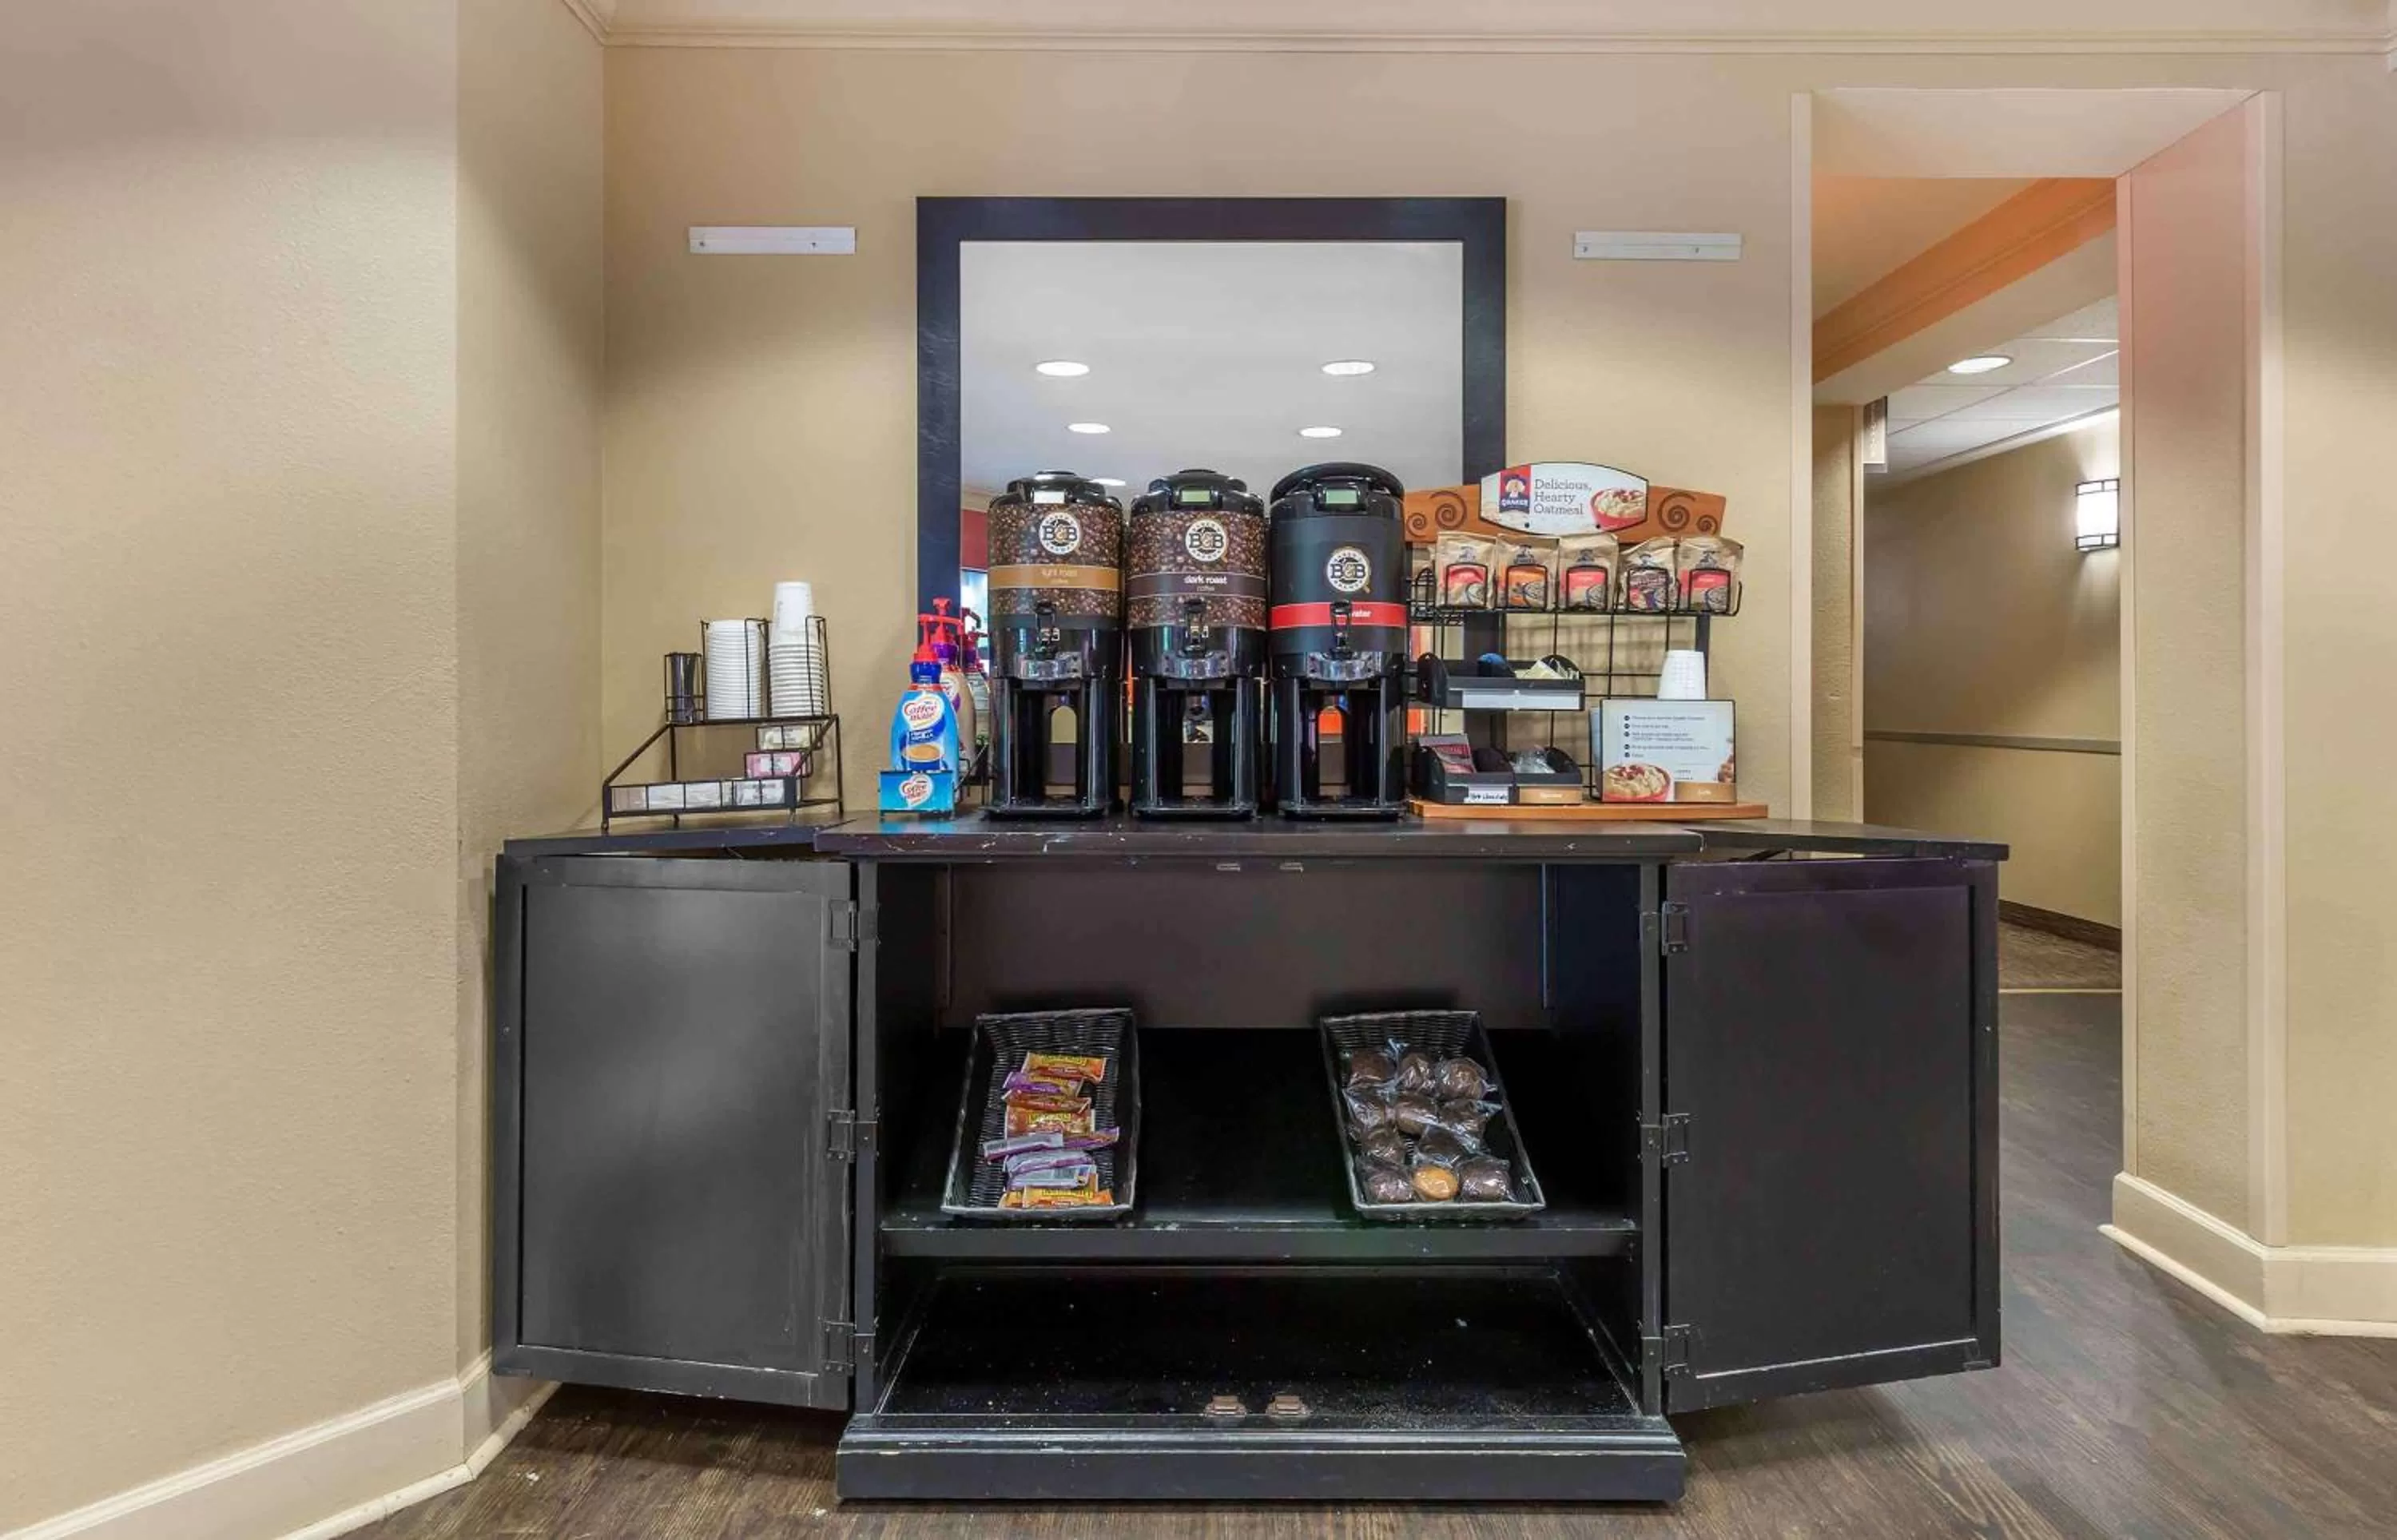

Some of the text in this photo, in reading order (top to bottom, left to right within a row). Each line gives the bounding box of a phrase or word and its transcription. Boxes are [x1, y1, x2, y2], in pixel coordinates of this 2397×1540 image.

[1534, 478, 1592, 491] Delicious,
[1534, 491, 1576, 505] Hearty
[1534, 503, 1584, 515] Oatmeal
[1184, 574, 1228, 585] dark roast
